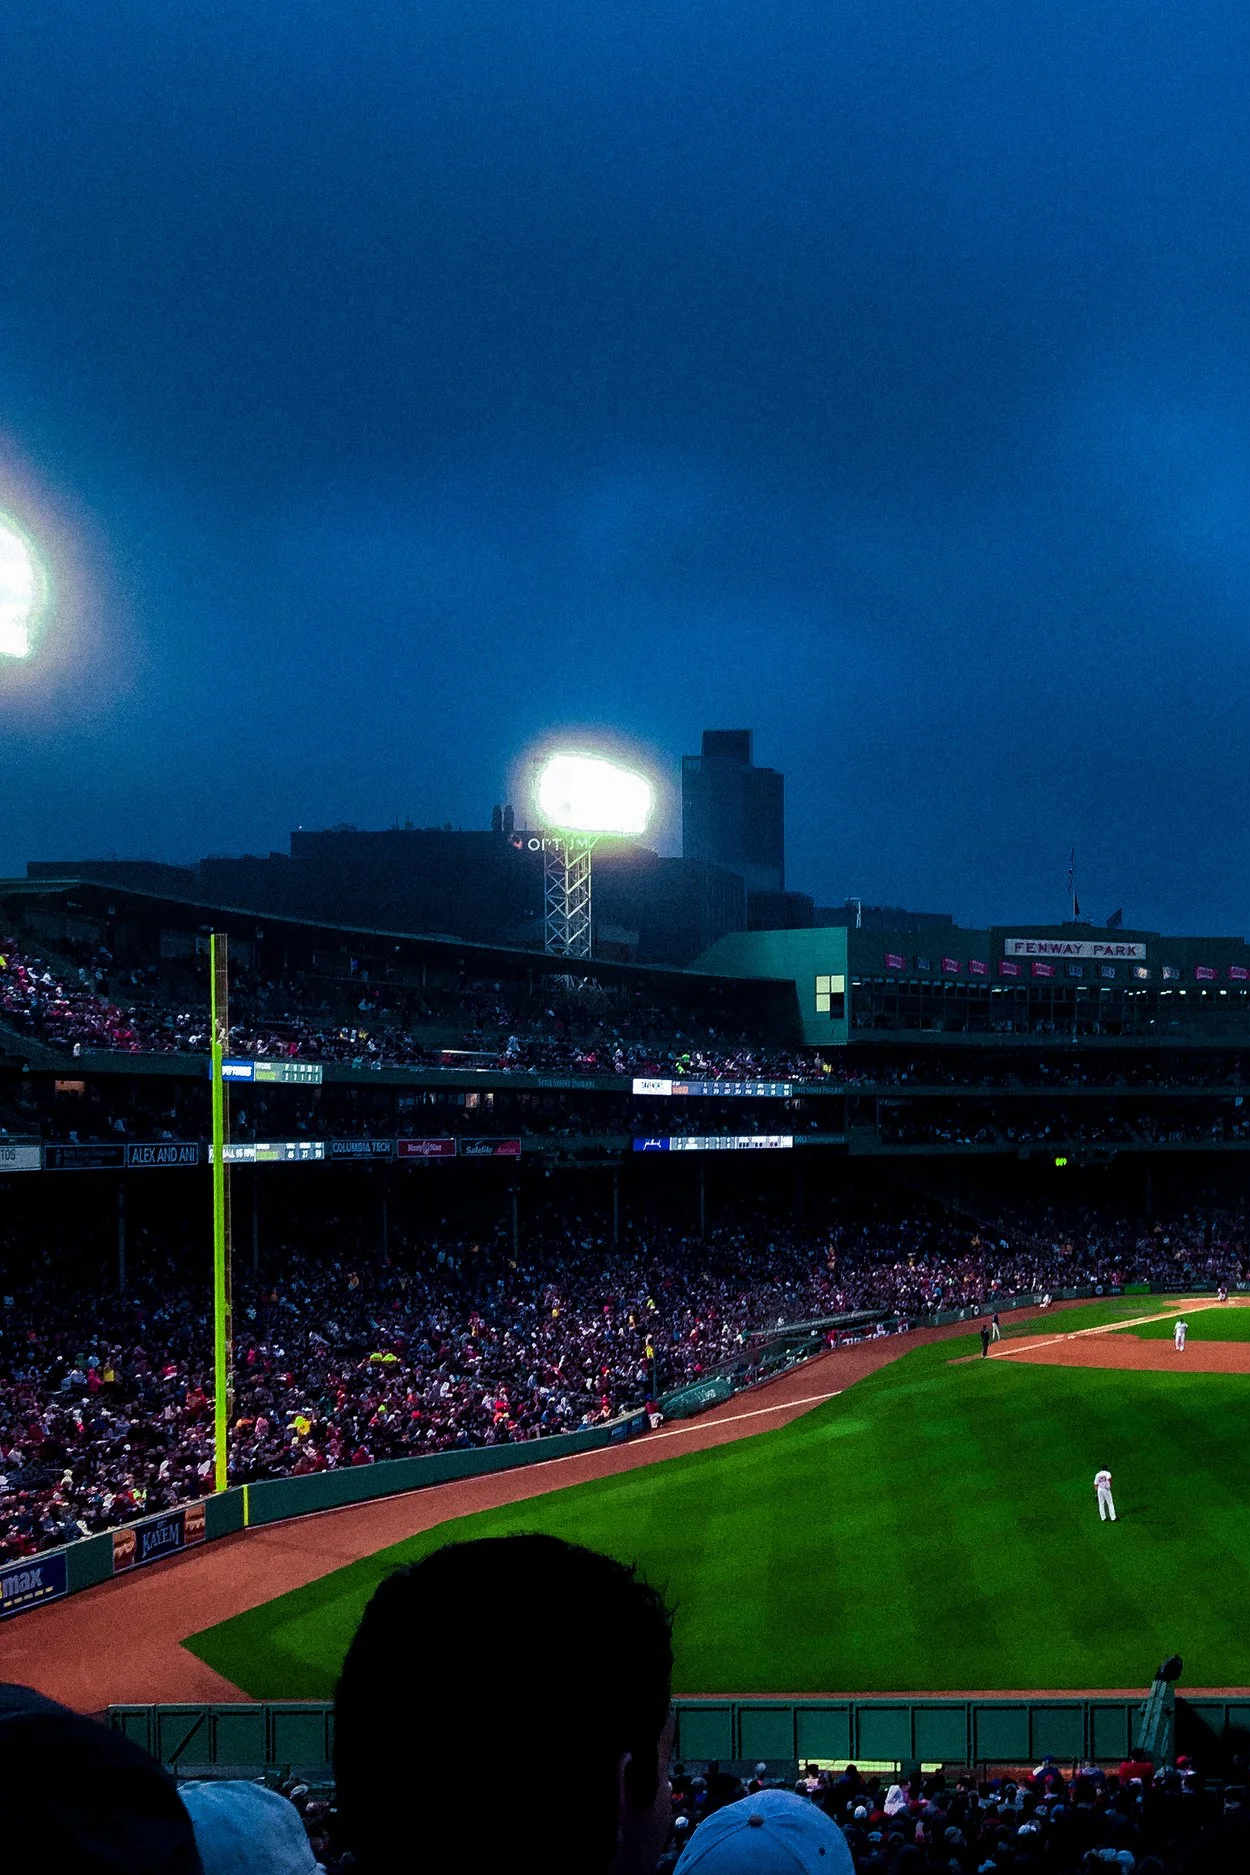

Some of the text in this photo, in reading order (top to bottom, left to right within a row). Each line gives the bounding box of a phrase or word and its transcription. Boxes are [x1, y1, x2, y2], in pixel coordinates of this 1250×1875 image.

[1013, 942, 1138, 957] FENWAY PARK
[132, 1146, 196, 1163] ALEX AND ANI
[332, 1142, 371, 1153] COLUMBIA
[372, 1142, 391, 1152] TECH
[141, 1522, 181, 1558] KAYEM
[0, 1567, 43, 1601] max
